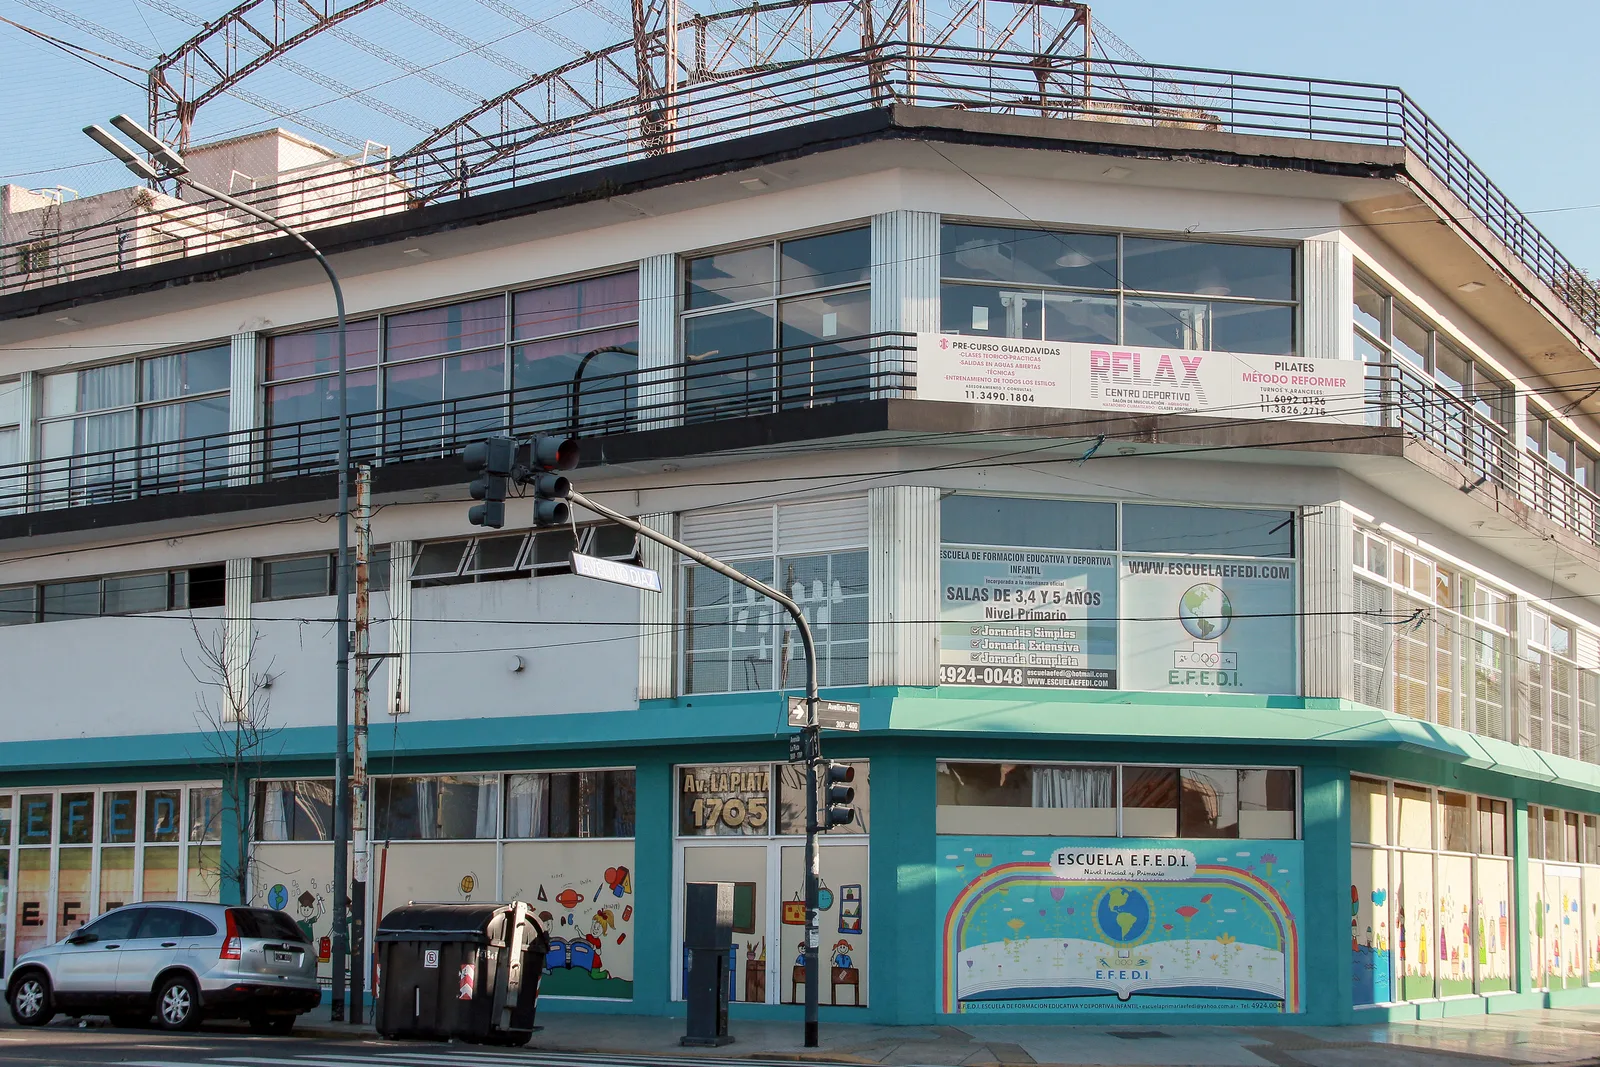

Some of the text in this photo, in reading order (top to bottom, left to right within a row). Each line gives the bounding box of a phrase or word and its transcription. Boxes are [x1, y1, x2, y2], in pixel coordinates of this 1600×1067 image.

[952, 341, 1060, 355] PRE-CURSO GUARDAVIDAS
[1274, 361, 1315, 373] PILATES
[1034, 379, 1056, 387] ESTILOS
[1090, 350, 1208, 405] RELAX
[1242, 370, 1347, 387] MÉTODO REFORMER
[965, 390, 1034, 403] 11.3490.1804
[1105, 388, 1190, 401] CENTRO DEPORTIVO
[1260, 394, 1326, 406] 11.6092.0126
[971, 551, 981, 560] DE
[982, 552, 1025, 562] FORMACION
[1026, 553, 1065, 564] EDUCATIVA
[1066, 555, 1071, 564] Y
[1073, 555, 1111, 566] DEPORTIVA
[583, 560, 656, 587] AVELINO DIAZ
[1010, 565, 1041, 575] INFANTIL
[1128, 560, 1290, 580] WWW.ESCUELAEFEDI.COM
[985, 578, 1014, 586] Incorporada
[947, 586, 1101, 606] SALAS DE 3,4 Y 5 AÑOS
[985, 606, 1067, 621] Nivel Primario
[981, 625, 1076, 640] Jornadas Simples
[981, 638, 1080, 652] Jornada Extensiva
[981, 652, 1078, 667] Jornada Completa
[940, 666, 1023, 684] 4924-0048
[1027, 669, 1109, 678] escuelaefedi@hotmail.com
[1168, 669, 1243, 687] E.F.E.D.I.
[1027, 678, 1109, 687] WWW.ESCUELAEFEDI.COM
[827, 702, 846, 712] Avelino
[692, 797, 768, 828] 1705
[1057, 853, 1189, 868] ESCUELA E.F.E.D.I.
[1136, 869, 1165, 877] Primario
[1095, 969, 1152, 980] E.F.E.D.I.
